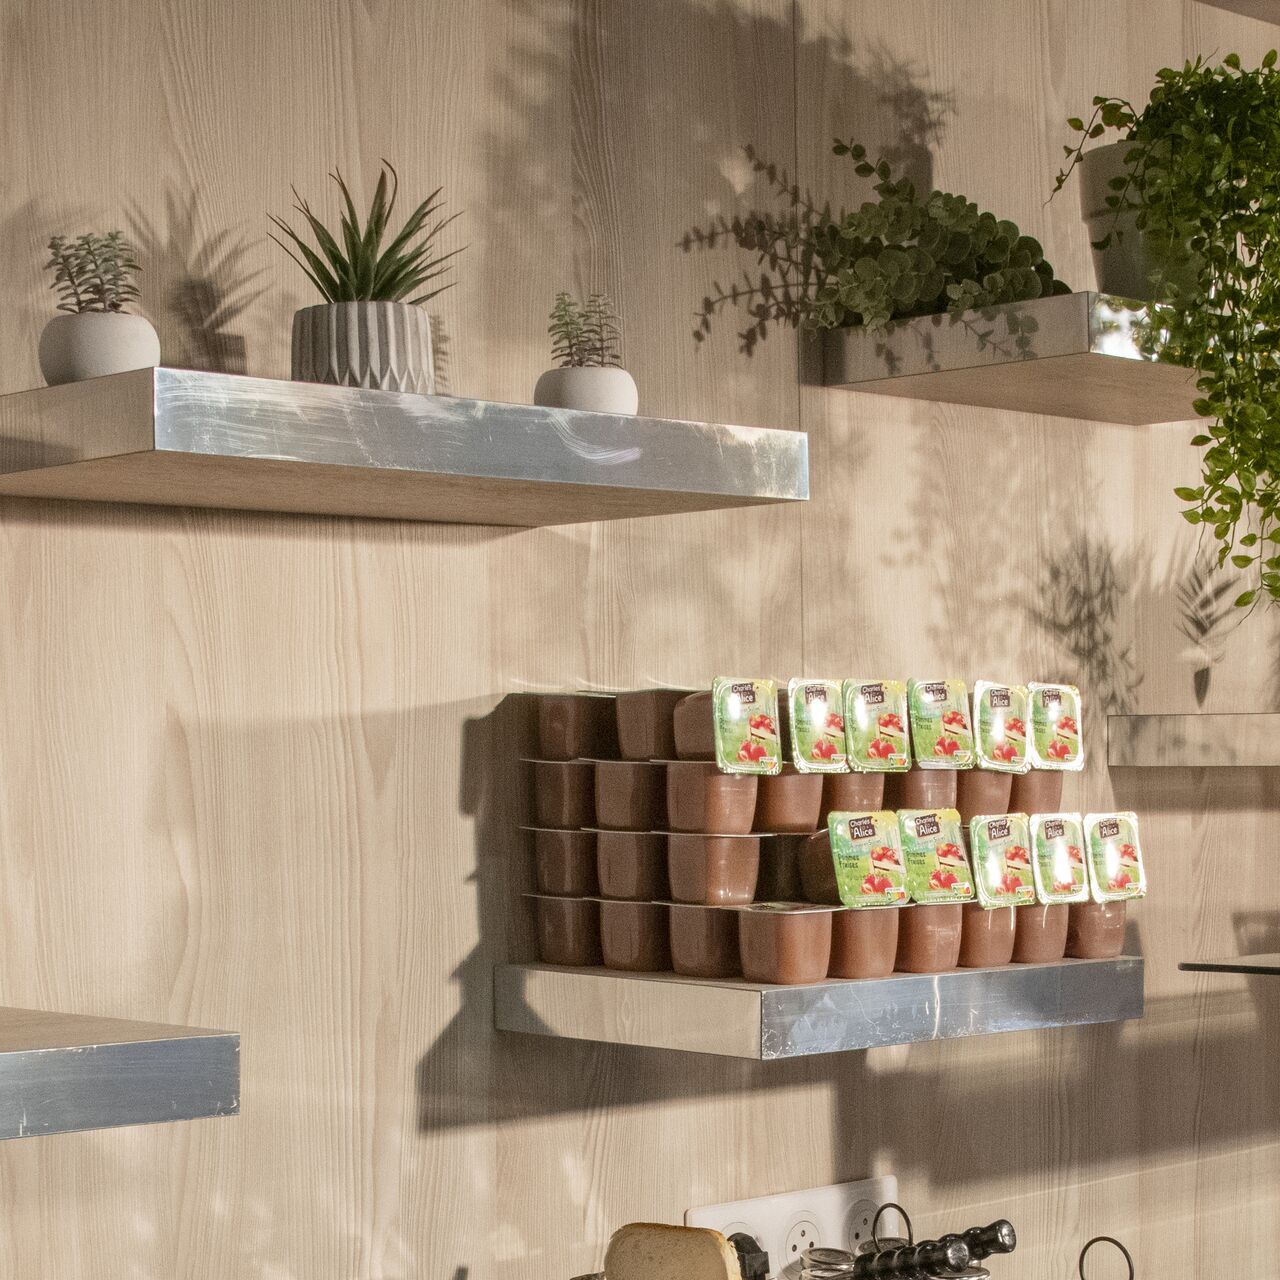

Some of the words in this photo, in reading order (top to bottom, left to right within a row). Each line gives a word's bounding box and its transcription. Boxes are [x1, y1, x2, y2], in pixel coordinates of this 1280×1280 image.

[853, 827, 874, 839] Alice
[919, 824, 939, 837] Alice
[991, 828, 1009, 839] Alice
[1047, 828, 1064, 839] Alice
[1102, 828, 1119, 838] Alice
